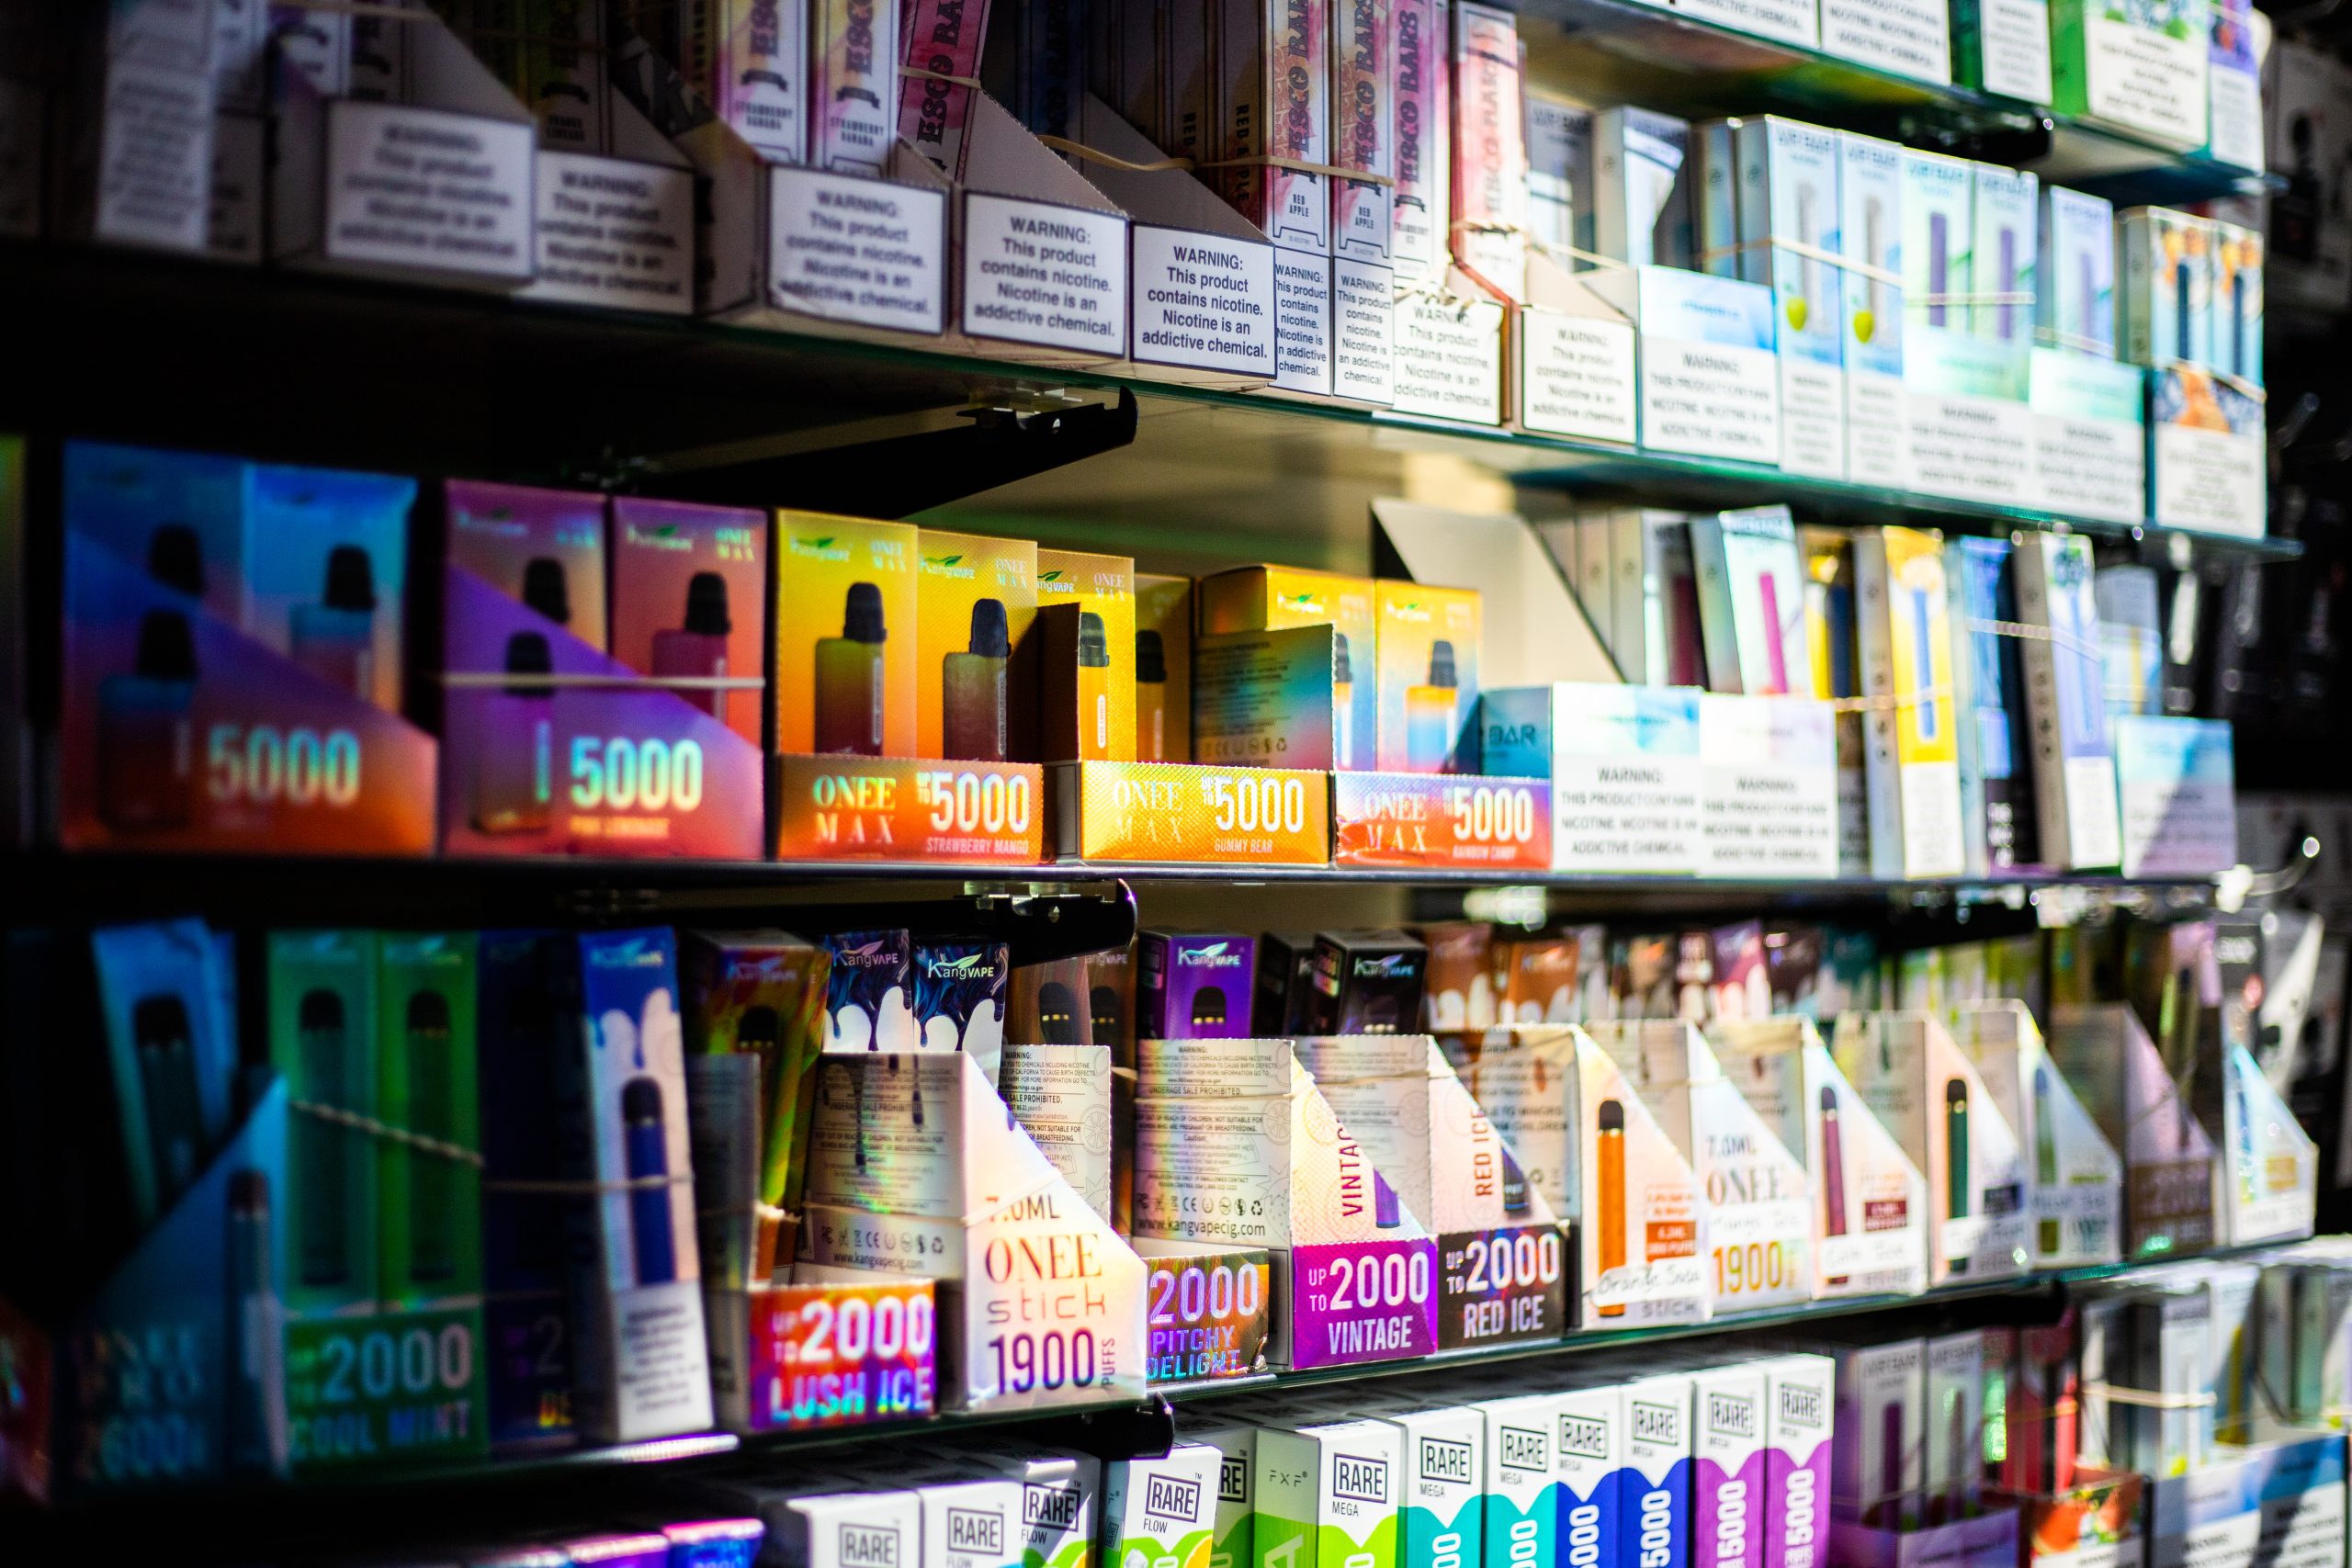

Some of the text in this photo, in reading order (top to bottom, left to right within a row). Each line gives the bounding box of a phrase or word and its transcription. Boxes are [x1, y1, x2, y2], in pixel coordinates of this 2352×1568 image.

[917, 54, 954, 146] ESCO
[1288, 66, 1308, 153] ESCO
[1399, 10, 1419, 183] ESCO BARS
[1236, 105, 1249, 139] RED
[1355, 81, 1375, 167] ESCO
[1289, 205, 1308, 217] APPLE
[1294, 194, 1305, 205] RED
[1359, 207, 1370, 217] RED
[809, 212, 908, 243] This product
[1012, 217, 1090, 244] WARNING:
[1355, 217, 1374, 229] APPLE
[786, 234, 856, 257] contains
[1003, 238, 1096, 267] This product
[1174, 246, 1242, 270] WARNING:
[803, 259, 910, 288] Nicotine is an
[981, 260, 1112, 292] contains nicotine.
[1167, 267, 1248, 293] This product
[1276, 265, 1323, 283] WARNING:
[1341, 275, 1386, 293] WARNING:
[780, 280, 853, 302] addictive
[997, 283, 1096, 311] Nicotine is an
[1148, 288, 1262, 316] contains nicotine.
[1294, 286, 1327, 299] product
[1338, 290, 1391, 310] This product
[1281, 299, 1318, 313] contains
[1346, 310, 1382, 323] contains
[974, 304, 1114, 337] addictive chemical.
[1163, 310, 1250, 334] Nicotine is an
[1281, 314, 1318, 329] nicotine.
[1347, 324, 1382, 339] nicotine.
[1143, 330, 1267, 358] addictive chemical.
[1277, 328, 1323, 345] Nicotine is
[1342, 338, 1386, 355] Nicotine is
[1287, 346, 1326, 362] addictive
[1339, 355, 1390, 371] an addictive
[1279, 361, 1320, 377] chemical.
[995, 559, 1026, 574] ONEE
[997, 573, 1027, 588] MAX
[1094, 574, 1125, 588] ONEE
[1095, 588, 1125, 601] MAX
[1489, 725, 1535, 745] BAR
[208, 723, 359, 807] 5000
[571, 737, 703, 811] 5000
[813, 775, 896, 810] ONEE
[932, 772, 1029, 833] 5000
[1114, 781, 1182, 810] ONEE
[1215, 776, 1304, 832] 5000
[1364, 794, 1427, 821] ONEE
[1453, 786, 1533, 842] 5000
[816, 813, 894, 844] MAX
[1116, 817, 1182, 843] MAX
[1366, 825, 1426, 851] MAX
[926, 838, 1028, 854] STRAWBERRY MANGO
[1215, 838, 1272, 852] GUMMY BEAR
[1453, 844, 1516, 860] RAINBOW CANDY
[832, 945, 899, 968] KangVAPE
[928, 959, 994, 980] KangVAPE
[1178, 945, 1242, 967] KangVAPE
[1353, 958, 1416, 977] KangVAPE
[1475, 1153, 1493, 1197] RED
[1138, 1217, 1265, 1238] www.kangvapecig.com
[985, 1234, 1102, 1283] ONEE
[1446, 1251, 1464, 1269] UP
[1465, 1233, 1559, 1292] 2000
[1713, 1241, 1781, 1294] 1900
[1308, 1269, 1326, 1286] UP
[1329, 1251, 1429, 1310] 2000
[1446, 1276, 1464, 1294] TO
[987, 1283, 1106, 1325] stick
[1149, 1262, 1259, 1324] 2000
[1309, 1294, 1327, 1312] TO
[772, 1311, 798, 1333] UP
[799, 1294, 933, 1362] 2000
[1464, 1295, 1544, 1338] RED ICE
[1152, 1325, 1236, 1354] PITCHY
[1328, 1315, 1412, 1354] VINTAGE
[322, 1324, 471, 1403] 2000
[774, 1340, 798, 1363] TO
[989, 1327, 1094, 1395] 1900
[1102, 1337, 1114, 1386] PUFFS
[1146, 1348, 1240, 1380] DELIGHT
[771, 1367, 933, 1420] LUSH ICE
[1781, 1393, 1817, 1417] RARE
[1635, 1408, 1672, 1436] RARE
[1711, 1402, 1748, 1427] RARE
[1507, 1435, 1544, 1464] RARE
[1566, 1422, 1601, 1451] RARE
[1427, 1445, 1466, 1476] RARE
[1339, 1461, 1383, 1496] RARE
[1420, 1483, 1445, 1497] MEGA
[1500, 1472, 1522, 1484] MEGA
[1029, 1491, 1074, 1524] RARE
[1151, 1481, 1194, 1515] RARE
[1332, 1502, 1359, 1517] MEGA
[1785, 1469, 1815, 1546] 5000
[954, 1517, 1000, 1549] RARE
[1144, 1518, 1168, 1533] FLOW
[1640, 1490, 1671, 1568] 5000
[1717, 1480, 1747, 1559] 5000
[845, 1534, 894, 1563] RARE
[1022, 1529, 1047, 1544] FLOW
[1569, 1505, 1600, 1568] 000
